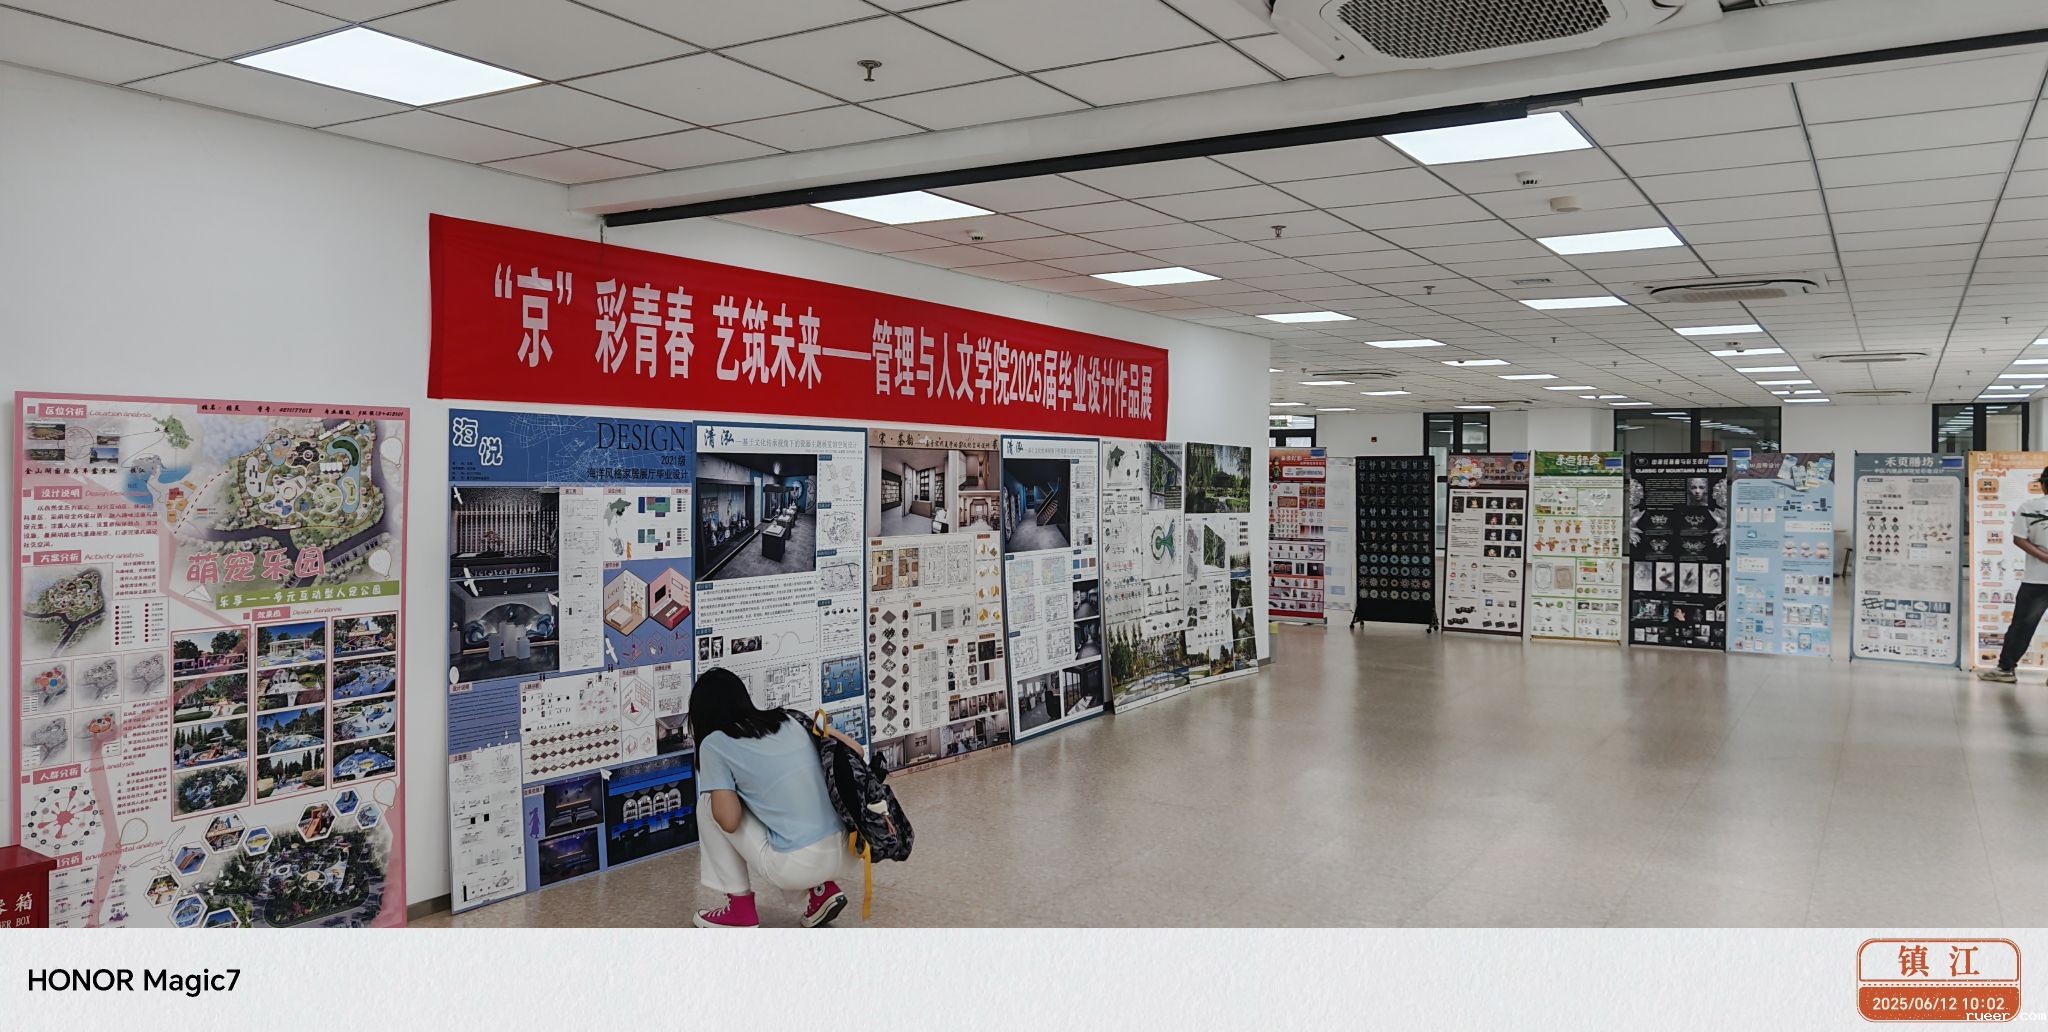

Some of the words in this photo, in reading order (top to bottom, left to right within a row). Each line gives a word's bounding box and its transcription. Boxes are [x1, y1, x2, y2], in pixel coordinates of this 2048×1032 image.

[494, 262, 573, 368] “京”
[595, 278, 694, 379] 彩青春
[45, 406, 84, 416] 区位分析
[452, 417, 503, 466] 海悦
[597, 422, 687, 451] DESIGN
[661, 455, 687, 467] 2021级
[587, 467, 689, 480] 海洋风格家居展厅毕业设计
[41, 488, 80, 498] 设计说明
[40, 552, 79, 563] 方案分析
[186, 546, 326, 585] 萌宠乐园
[40, 767, 78, 782] 人群分析
[16, 915, 30, 927] BOX
